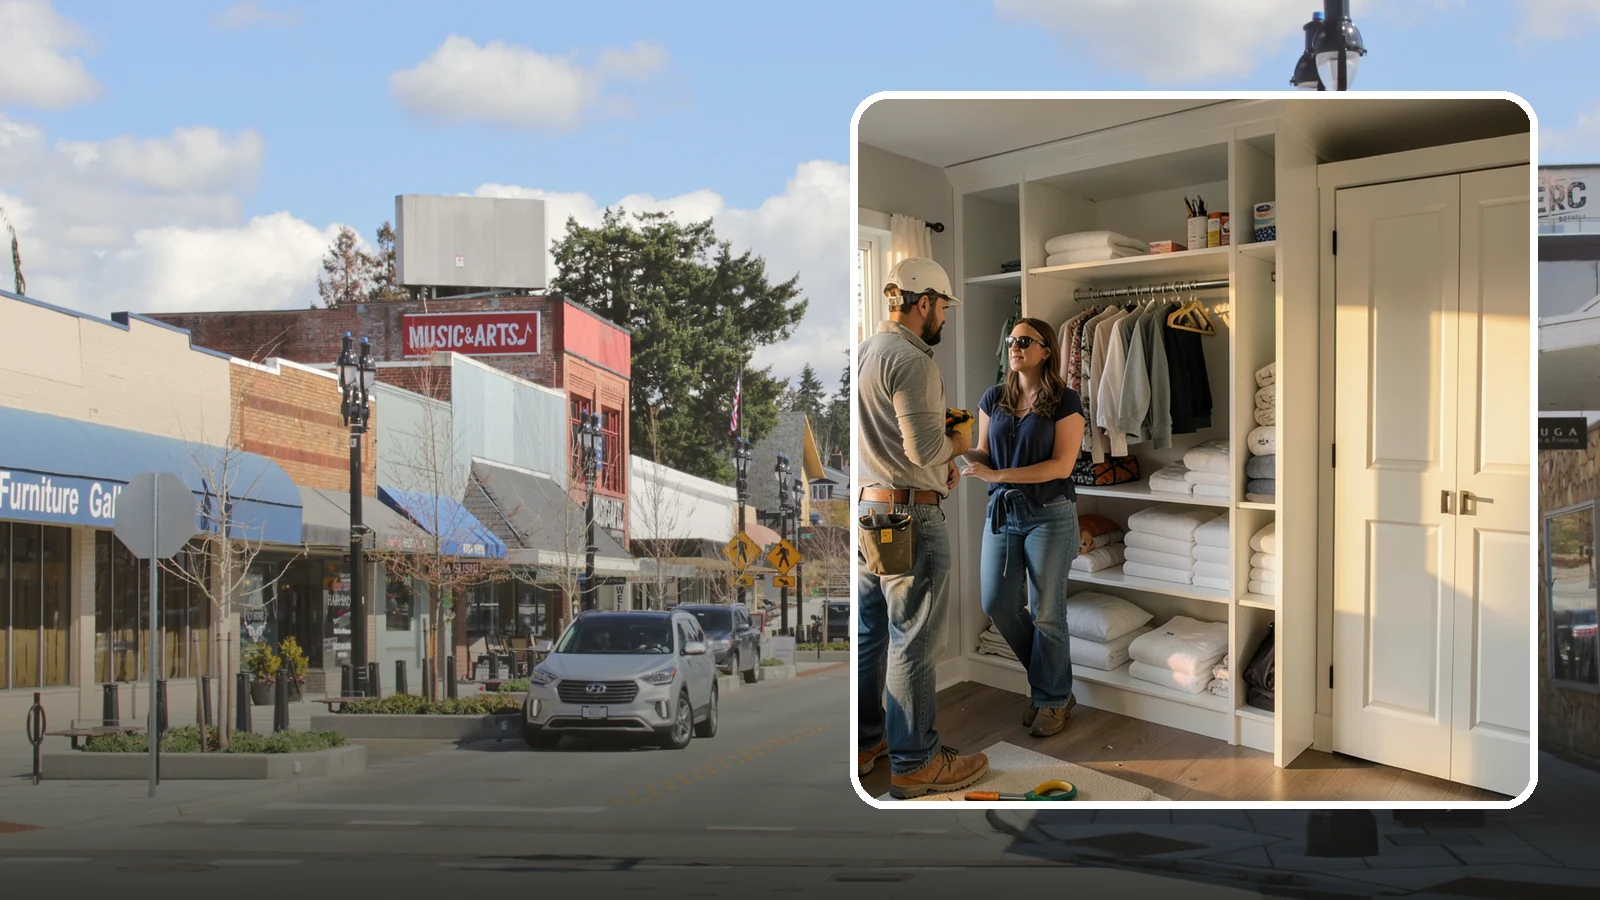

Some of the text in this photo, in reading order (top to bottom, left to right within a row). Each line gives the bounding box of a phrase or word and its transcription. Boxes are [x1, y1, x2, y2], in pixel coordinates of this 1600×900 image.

[409, 323, 519, 349] MUSIC&ARTS
[1540, 427, 1577, 436] UGA
[0, 471, 121, 519] Furniture Gal
